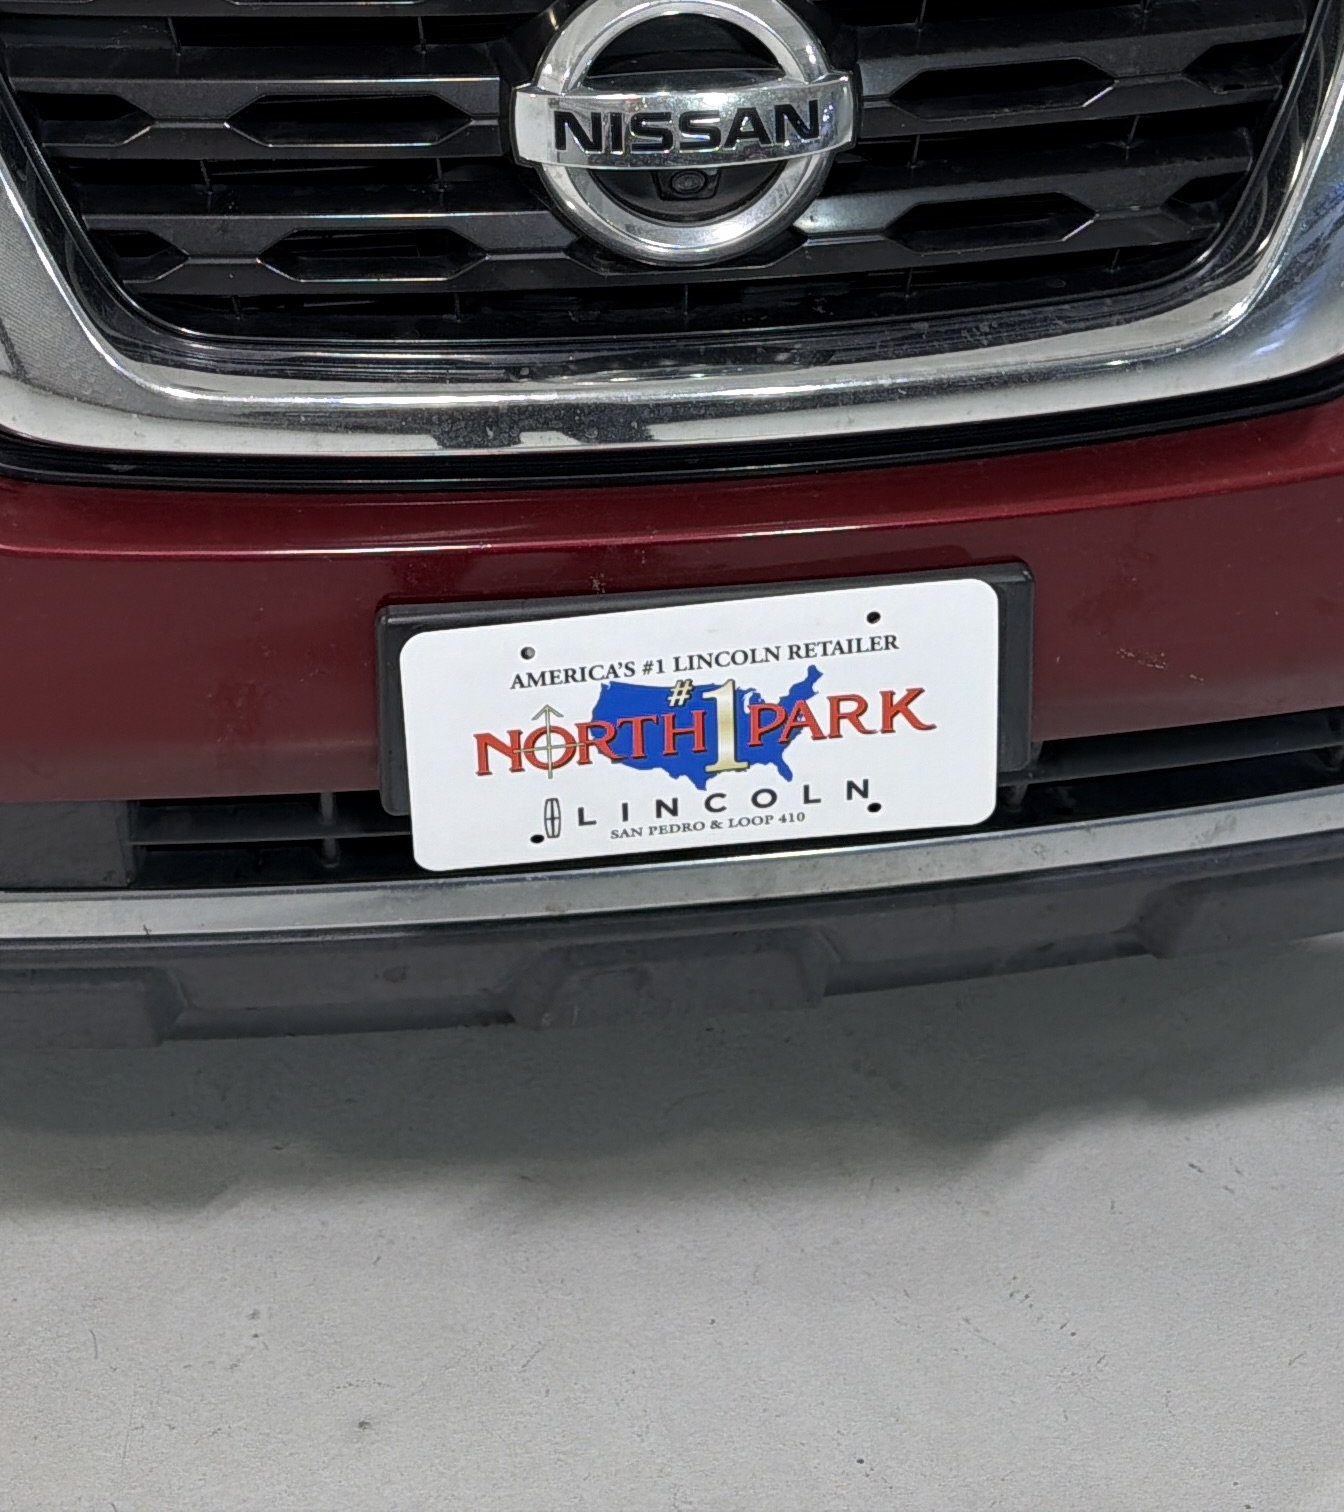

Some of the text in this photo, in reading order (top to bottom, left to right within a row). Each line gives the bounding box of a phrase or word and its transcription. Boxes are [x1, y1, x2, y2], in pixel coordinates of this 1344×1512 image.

[554, 99, 820, 153] NISSAN
[510, 634, 900, 690] AMERICA'S #1 LINCOLN RETAILER
[473, 687, 937, 776] NORTH PARK
[577, 778, 870, 826] LINCOLN
[610, 811, 806, 840] SAN PEDRO & LOOP 410
